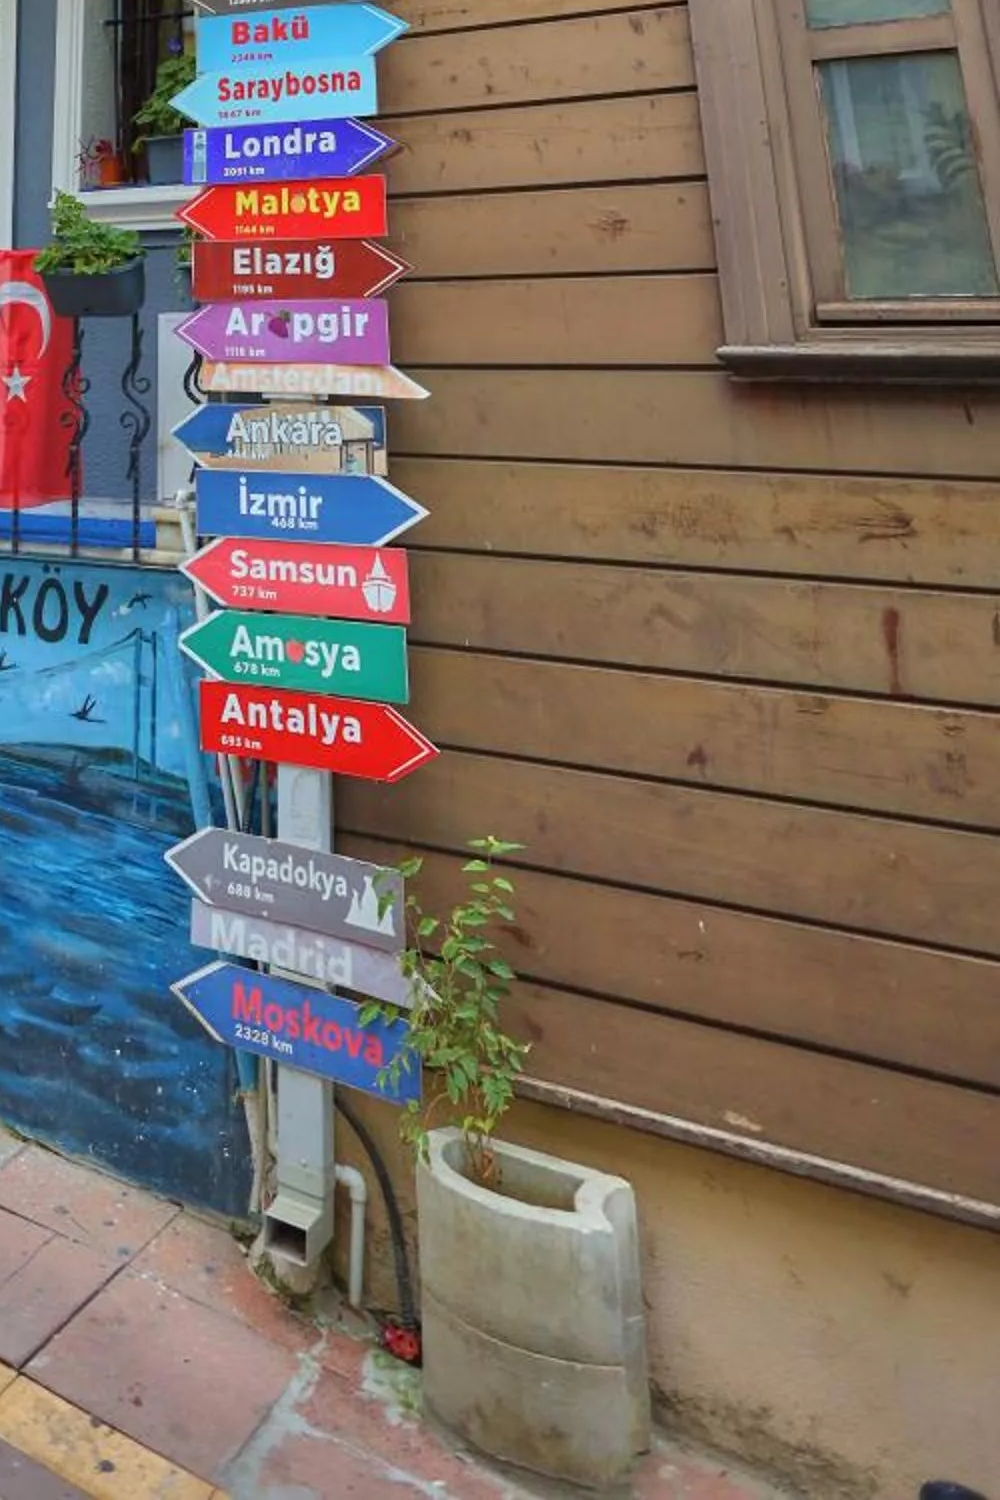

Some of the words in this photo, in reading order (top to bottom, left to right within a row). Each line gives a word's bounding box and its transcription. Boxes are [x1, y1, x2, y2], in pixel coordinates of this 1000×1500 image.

[231, 14, 309, 45] Bakü
[218, 69, 361, 102] Saraybosna
[224, 128, 336, 159] Londra
[249, 165, 265, 175] km
[235, 187, 361, 219] Maltya
[258, 225, 275, 234] km
[232, 246, 335, 279] Elazığ
[257, 284, 273, 293] km
[225, 306, 369, 342] Arpgir
[248, 346, 266, 357] km
[210, 363, 384, 393] Amsterdam
[226, 411, 343, 446] Ankara
[239, 475, 323, 519] İzmir
[272, 518, 296, 529] 468
[299, 518, 318, 531] km
[230, 549, 358, 587] Samsun
[232, 586, 254, 597] 737
[257, 587, 277, 599] km
[230, 625, 361, 678] Amsya
[233, 662, 258, 675] 678
[261, 665, 280, 677] km
[220, 693, 363, 745] Antalya
[244, 737, 262, 750] km
[223, 842, 349, 901] Kapadokya
[227, 882, 251, 898] 688
[254, 887, 275, 904] km
[210, 912, 352, 986] Madrid
[231, 979, 385, 1068] Moskova
[234, 1023, 269, 1046] 2328
[271, 1033, 293, 1055] km
